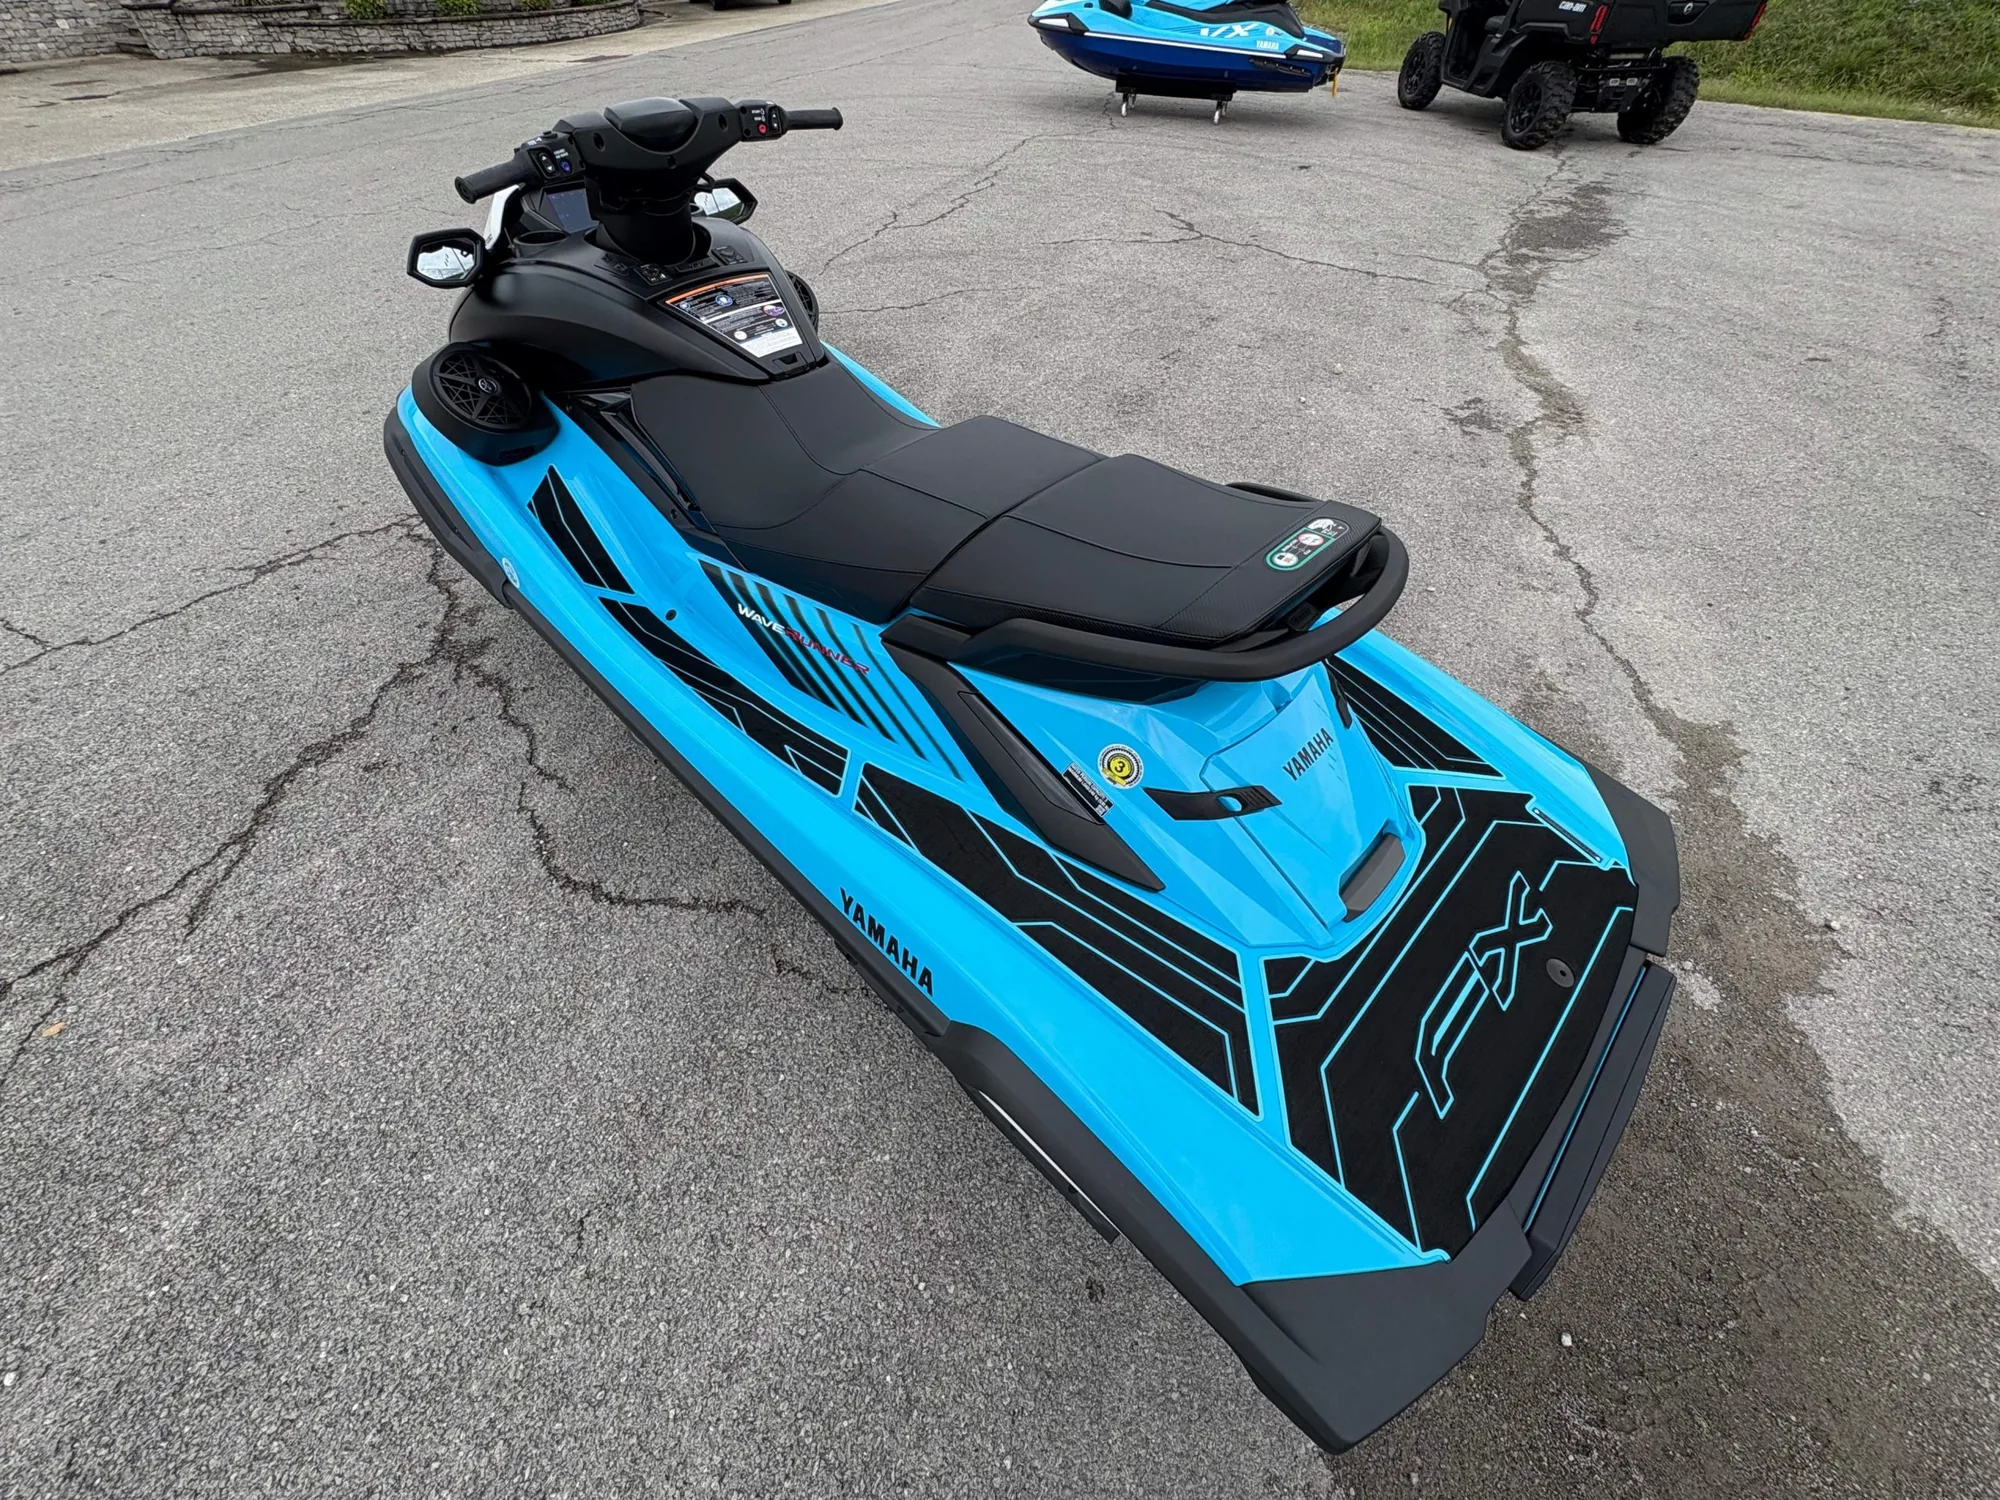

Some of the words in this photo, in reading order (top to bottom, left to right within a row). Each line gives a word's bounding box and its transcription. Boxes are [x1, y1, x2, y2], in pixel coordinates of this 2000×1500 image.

[1256, 40, 1280, 50] YAMAHA
[1114, 760, 1126, 774] 3
[1282, 727, 1334, 782] YAMAHA
[839, 886, 934, 997] YAMAHA
[1414, 870, 1554, 1120] FX
